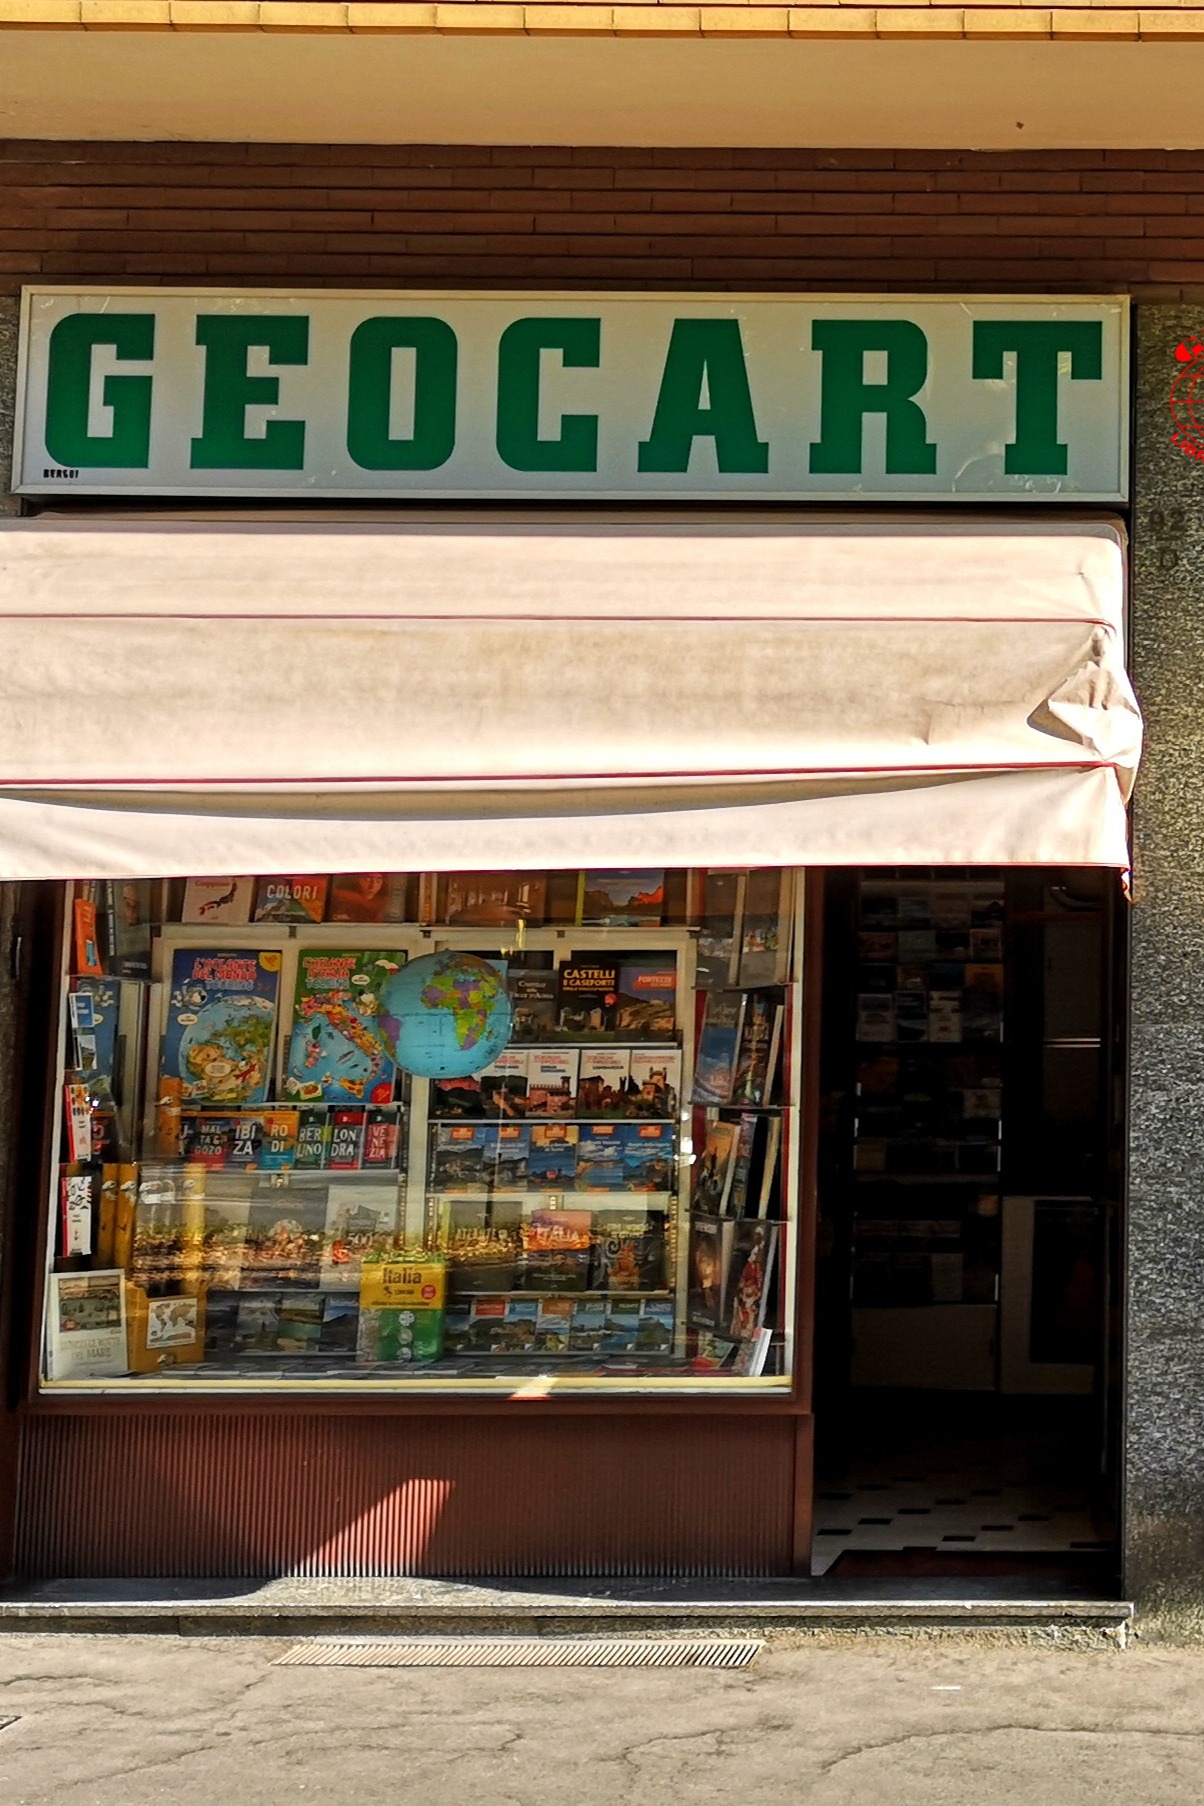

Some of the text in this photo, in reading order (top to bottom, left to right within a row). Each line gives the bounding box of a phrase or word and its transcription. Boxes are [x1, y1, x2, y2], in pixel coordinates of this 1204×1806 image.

[45, 313, 1102, 475] GEOCART
[267, 885, 318, 900] COLORI
[563, 969, 616, 979] CASTELLI
[382, 1267, 422, 1284] Italia
